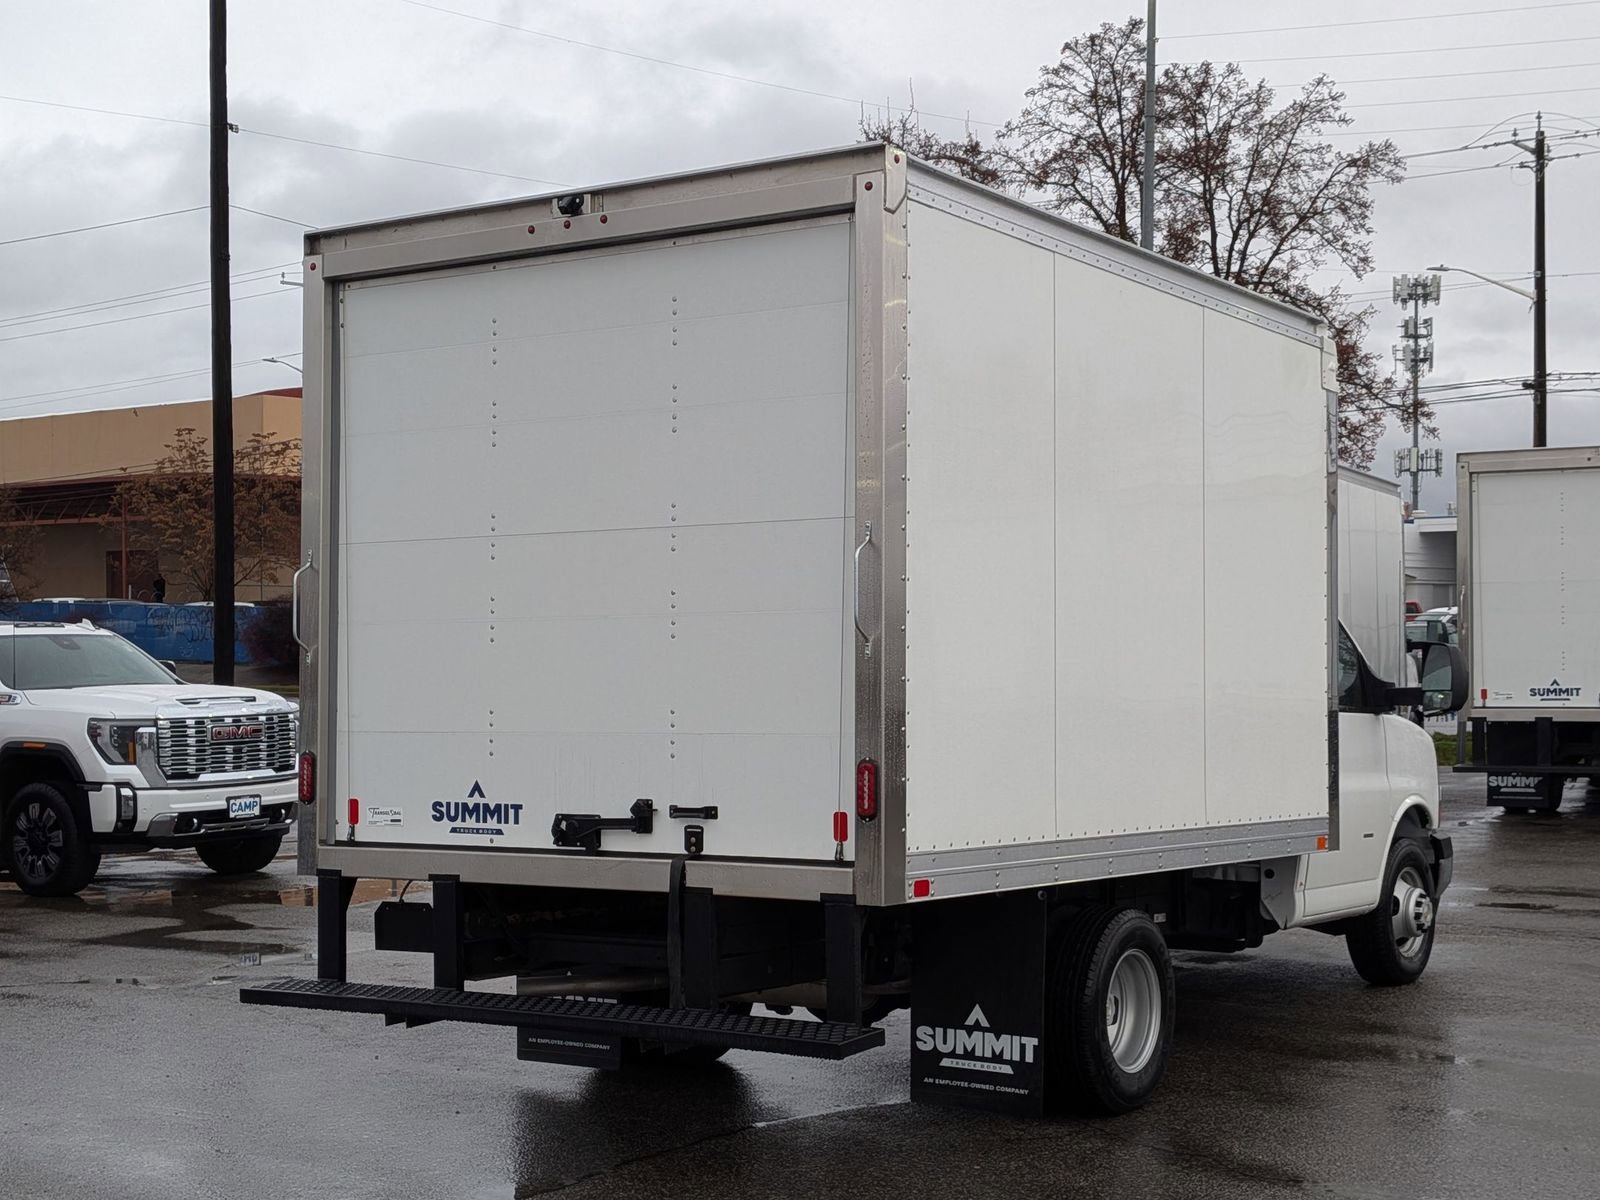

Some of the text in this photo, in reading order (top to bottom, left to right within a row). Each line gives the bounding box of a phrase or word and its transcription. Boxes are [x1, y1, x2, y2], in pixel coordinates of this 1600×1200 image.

[1529, 687, 1582, 697] SUMMIT
[212, 725, 264, 740] GMC
[230, 800, 258, 813] CAMP
[431, 800, 524, 825] SUMMIT
[915, 1025, 1039, 1063] SUMMIT
[935, 1078, 995, 1091] EMPLOYEE-OWNED
[996, 1086, 1029, 1095] COMPANY
